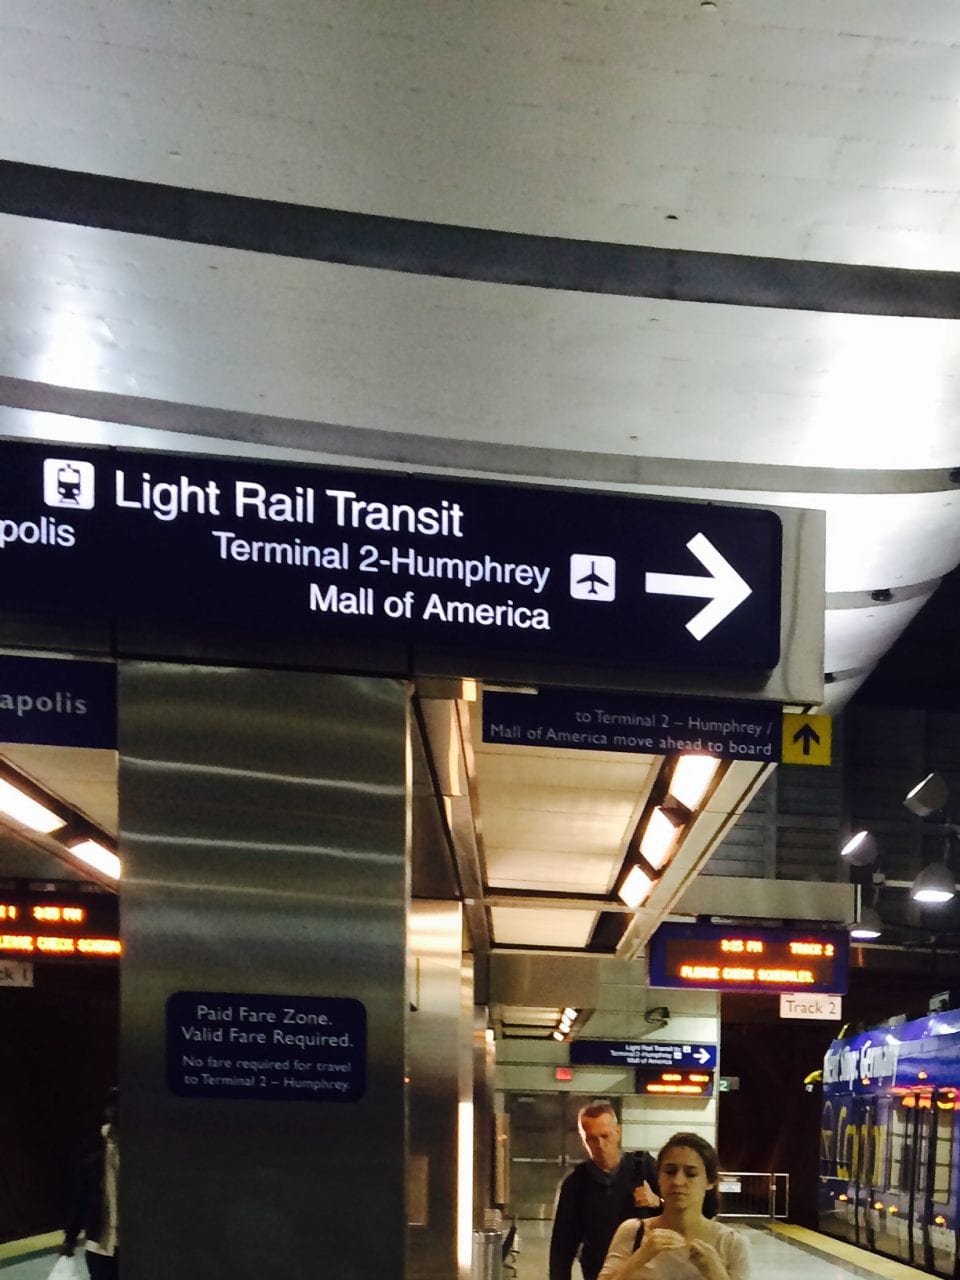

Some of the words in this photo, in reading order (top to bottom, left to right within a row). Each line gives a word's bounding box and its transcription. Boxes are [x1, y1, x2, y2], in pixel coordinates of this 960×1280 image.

[115, 470, 220, 521] Light
[235, 481, 314, 524] Rail
[325, 489, 464, 538] Transit
[212, 530, 348, 570] Terminal
[359, 544, 551, 594] 2-Humphrey
[310, 583, 374, 616] Mall
[384, 591, 414, 619] of
[423, 593, 551, 630] America
[576, 711, 592, 722] to
[594, 709, 656, 728] Terminal
[661, 715, 669, 727] 2
[688, 716, 763, 736] Humphrey
[490, 723, 521, 740] Mall
[527, 726, 544, 740] of
[546, 728, 608, 745] America
[613, 735, 653, 748] move
[658, 736, 701, 751] ahead
[708, 739, 724, 753] to
[729, 739, 773, 756] board
[197, 1005, 233, 1022] Paid
[239, 1006, 277, 1023] Fare
[283, 1008, 333, 1026] Zone.
[786, 1000, 823, 1015] Track
[829, 1001, 837, 1015] 2
[181, 1026, 223, 1042] Valid
[229, 1028, 267, 1044] Fare
[273, 1029, 354, 1050] Required.
[182, 1055, 204, 1068] No
[207, 1056, 233, 1069] fare
[236, 1058, 291, 1073] required
[293, 1059, 313, 1071] for
[316, 1061, 353, 1074] travel
[184, 1075, 199, 1086] to
[200, 1073, 256, 1088] Terminal
[259, 1076, 267, 1087] 2
[283, 1077, 351, 1092] Humphrey.
